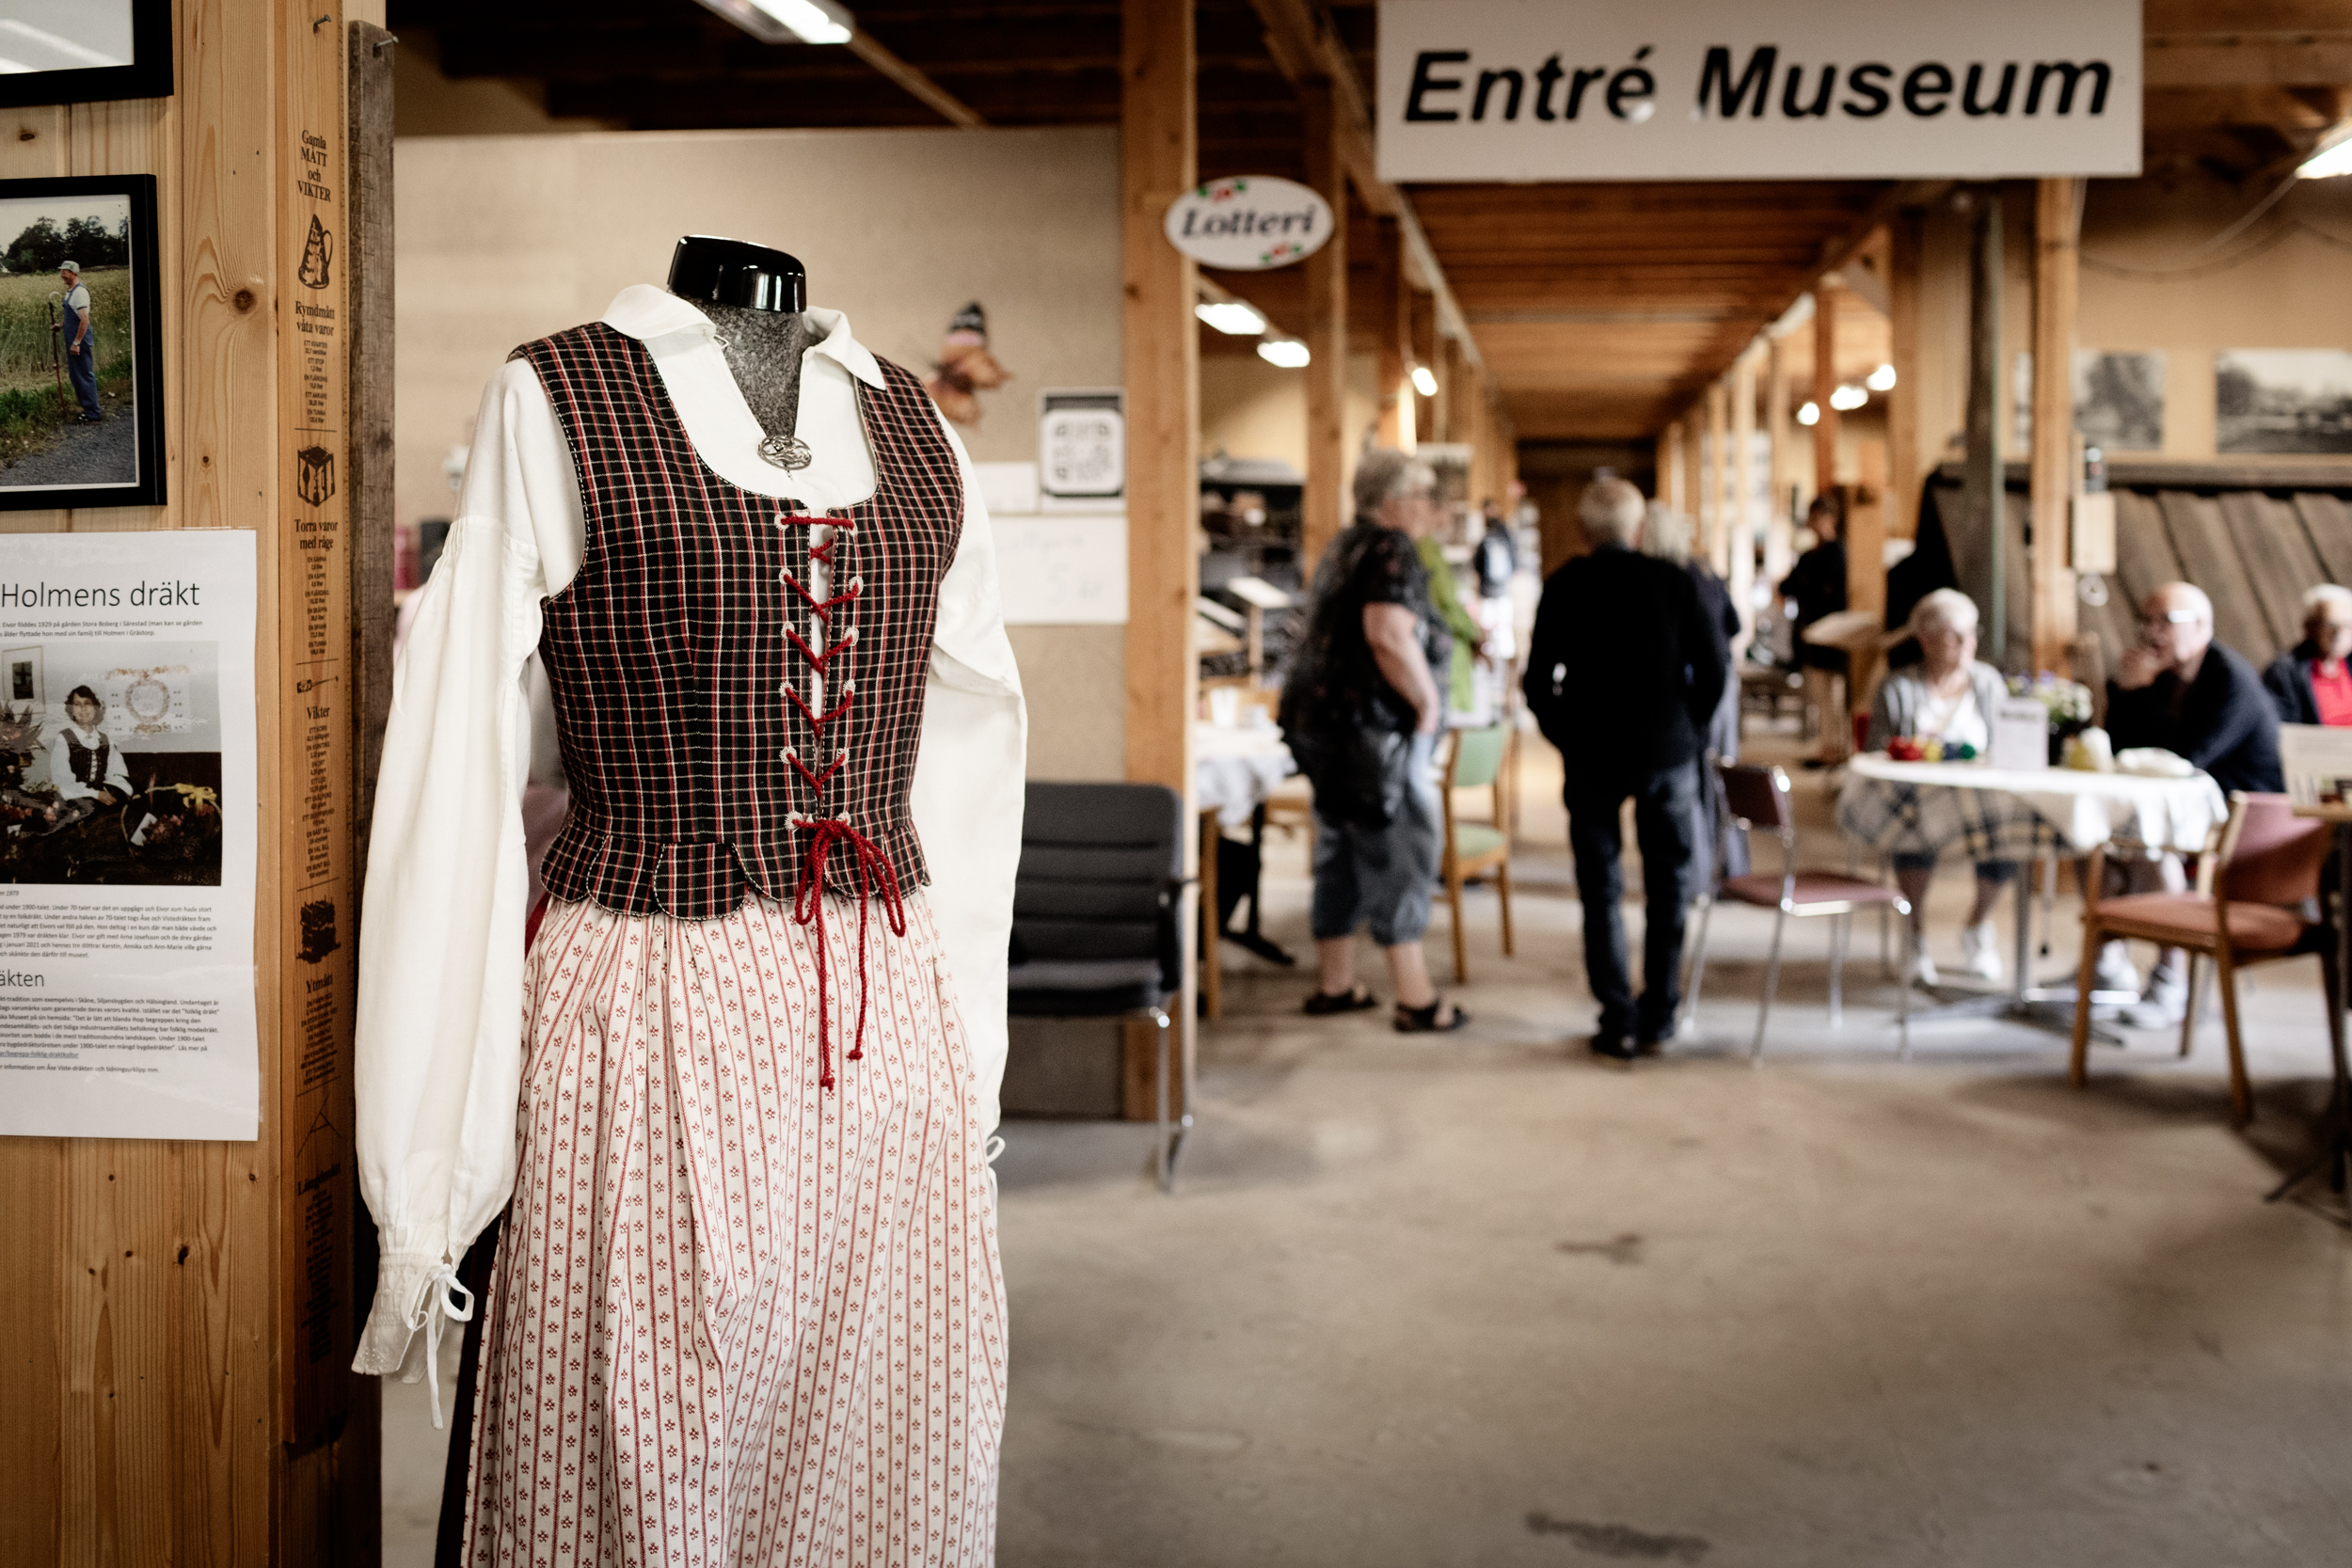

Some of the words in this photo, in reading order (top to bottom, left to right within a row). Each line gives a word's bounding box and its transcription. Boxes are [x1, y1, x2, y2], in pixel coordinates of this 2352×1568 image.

[1406, 44, 1656, 122] Entré
[1695, 44, 2113, 119] Museum
[301, 130, 326, 150] Gamla
[300, 145, 327, 166] MÅTT
[308, 169, 322, 182] och
[297, 180, 331, 202] VIKTER
[294, 301, 335, 320] Rymdmått
[296, 319, 313, 334] våta
[314, 324, 334, 336] varor
[294, 519, 317, 532] Torra
[319, 520, 338, 531] varor
[299, 535, 317, 549] med
[318, 534, 334, 551] råge
[2, 581, 120, 608] Holmens
[130, 579, 200, 607] dräkt
[307, 705, 330, 720] Vikter
